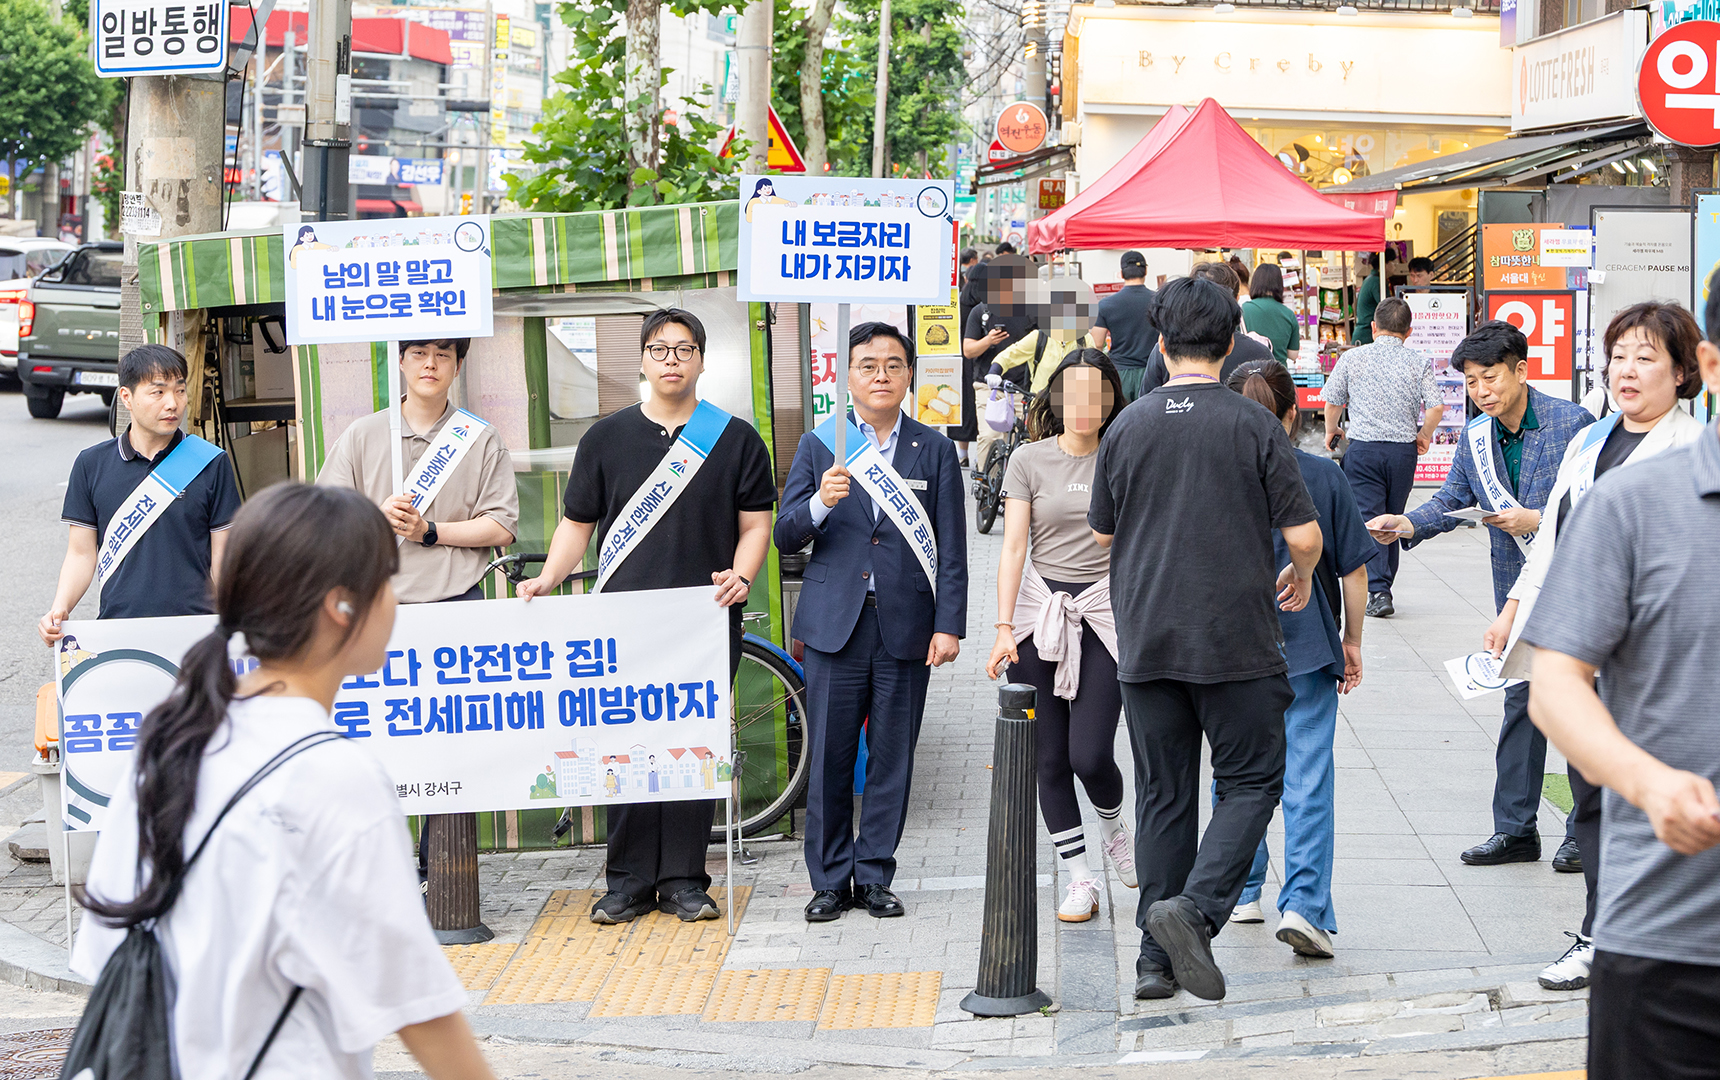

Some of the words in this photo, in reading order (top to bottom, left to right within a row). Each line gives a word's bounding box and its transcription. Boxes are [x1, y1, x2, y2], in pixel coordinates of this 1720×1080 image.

[102, 3, 220, 58] 일방통행
[1138, 50, 1186, 74] By
[1214, 51, 1354, 80] Creby
[1530, 57, 1558, 103] LOTTE
[1560, 45, 1595, 100] FRESH
[401, 164, 440, 182] 김선우
[782, 220, 806, 246] 내
[812, 220, 910, 249] 보금자리
[323, 262, 370, 289] 남의
[376, 260, 401, 286] 말
[406, 259, 453, 285] 말고
[781, 253, 831, 280] 내가
[835, 254, 911, 282] 지키자
[1500, 272, 1529, 284] 서울대
[312, 295, 335, 321] 내
[342, 293, 413, 320] 눈으로
[419, 290, 466, 316] 확인
[1494, 300, 1564, 374] 약
[416, 444, 457, 491] 신중한
[1475, 436, 1502, 500] 전세피해
[630, 481, 673, 527] 신중한
[864, 463, 920, 526] 전세피해
[109, 494, 157, 556] 전세피해
[433, 641, 554, 685] 안전한
[566, 638, 618, 678] 집!
[384, 690, 545, 737] 전세피해
[558, 680, 719, 727] 예방하자
[424, 781, 462, 796] 강서구
